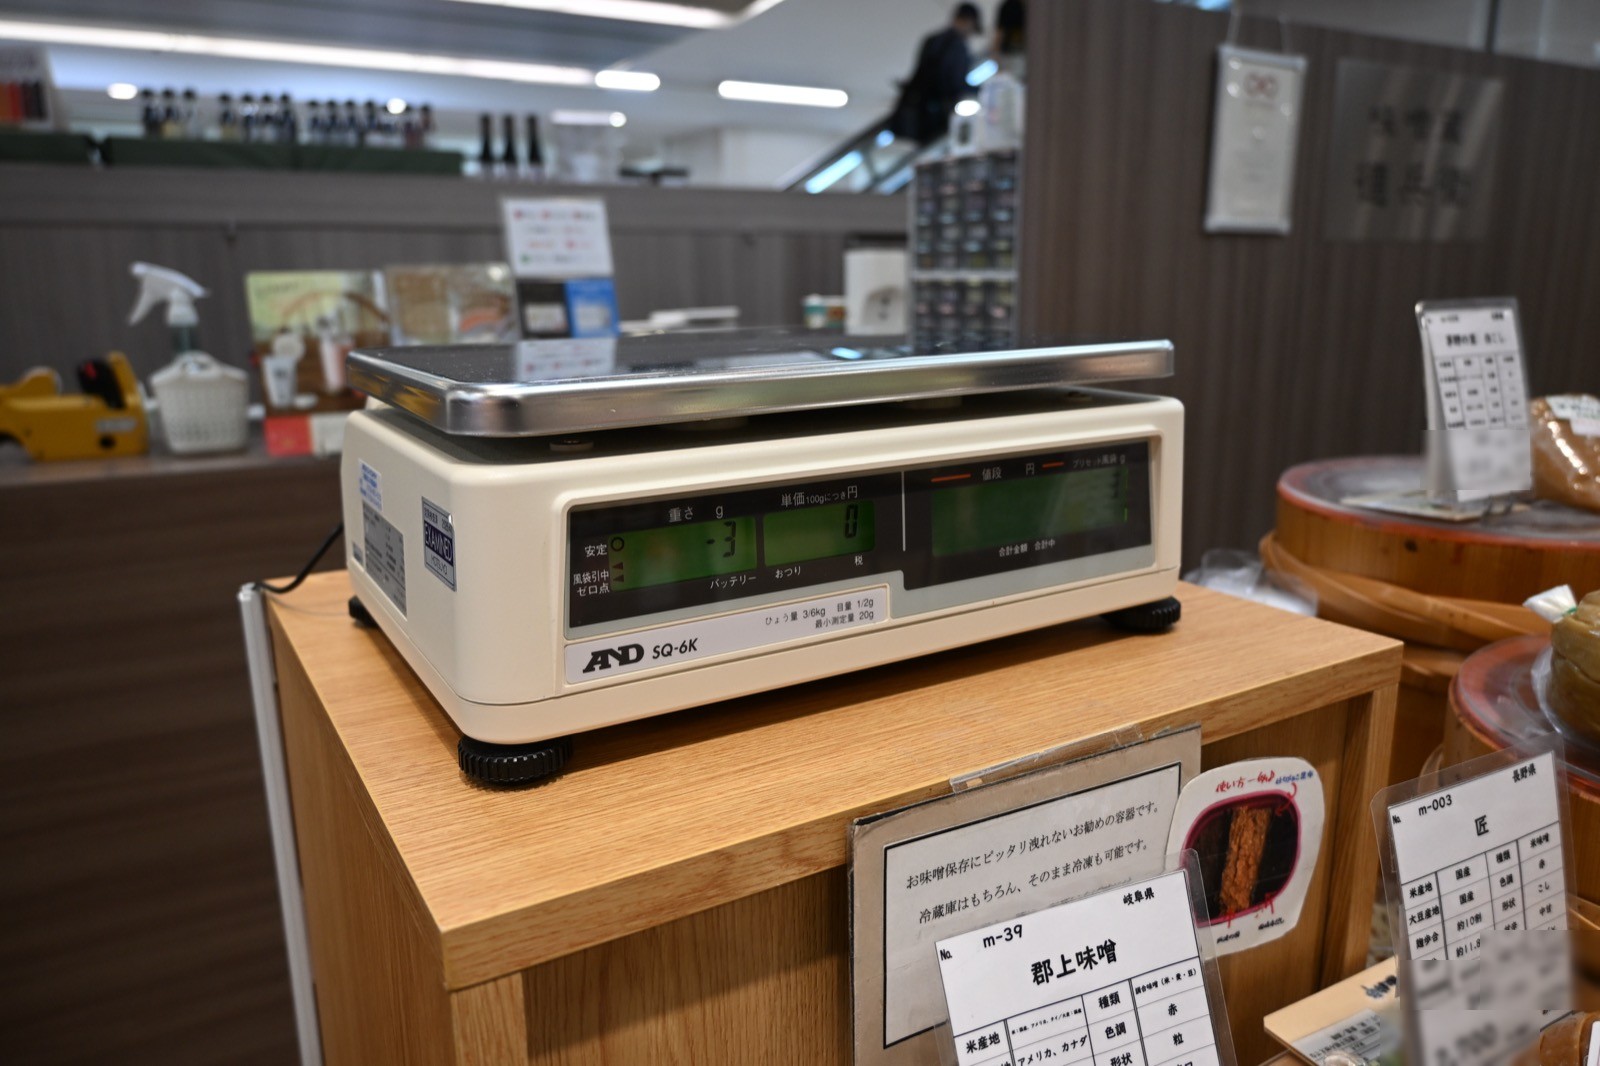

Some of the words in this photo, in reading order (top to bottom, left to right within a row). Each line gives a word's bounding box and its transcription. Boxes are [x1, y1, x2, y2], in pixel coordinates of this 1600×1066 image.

[982, 467, 1002, 481] 値段
[1025, 463, 1035, 476] 円
[668, 506, 693, 523] 重さ
[715, 505, 724, 519] g
[844, 503, 859, 539] 0
[425, 523, 454, 563] EXAMINED
[584, 543, 607, 557] 安定
[999, 543, 1028, 557] 合計金額
[1034, 539, 1056, 551] 合計中
[854, 555, 864, 566] 税
[573, 569, 609, 585] 風袋引中
[775, 565, 801, 579] おつり
[577, 583, 610, 597] ゼロ点
[710, 575, 757, 590] バッテリー
[765, 611, 798, 626] ひょう量
[803, 607, 826, 620] 3/6kg
[836, 601, 852, 613] 目量
[856, 598, 874, 610] 1/2g
[815, 613, 855, 630] 最小測定量
[859, 610, 874, 622] 20g
[582, 643, 645, 673] AND
[652, 638, 698, 660] SQ-6K
[1512, 763, 1536, 784] 長野県
[1418, 794, 1453, 816] m-003
[1474, 814, 1489, 837] 匠
[906, 800, 1159, 889] お味噌保存にピッタリ洩れないお勧めの容器です。
[1455, 866, 1471, 880] 国産
[1123, 887, 1155, 906] 岐阜県
[1409, 881, 1433, 898] 米産地
[1538, 881, 1550, 893] こし
[1459, 891, 1475, 905] 国産
[1409, 905, 1440, 926] 大豆産地
[982, 924, 1024, 949] m-39
[1031, 939, 1118, 986] 郡上味噌
[1098, 990, 1121, 1010] 種類
[1167, 1003, 1178, 1017] 赤
[1104, 1021, 1127, 1040] 色調
[1172, 1032, 1184, 1046] 粒
[966, 1031, 1001, 1054] 米産地
